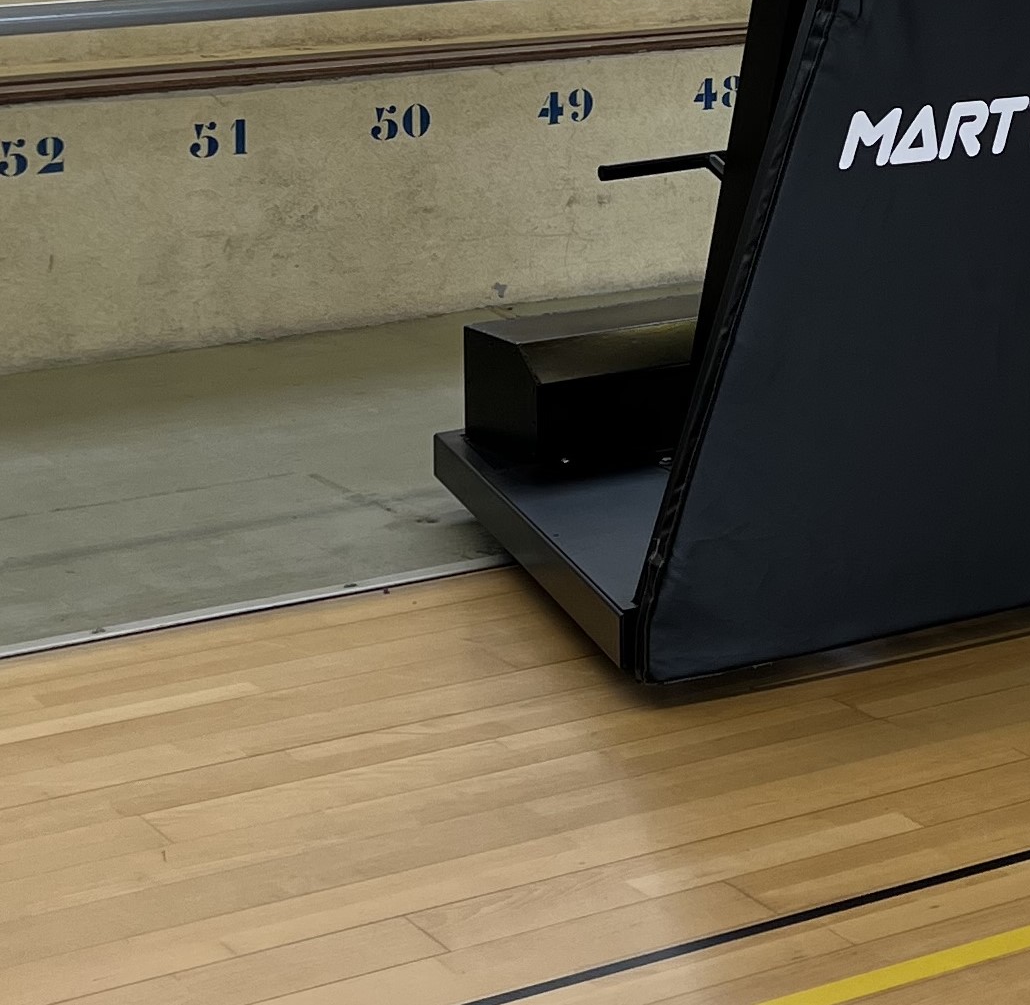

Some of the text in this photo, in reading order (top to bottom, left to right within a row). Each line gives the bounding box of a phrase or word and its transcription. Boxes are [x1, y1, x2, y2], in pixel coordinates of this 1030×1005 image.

[0, 75, 740, 176] 52 51 50 49 48
